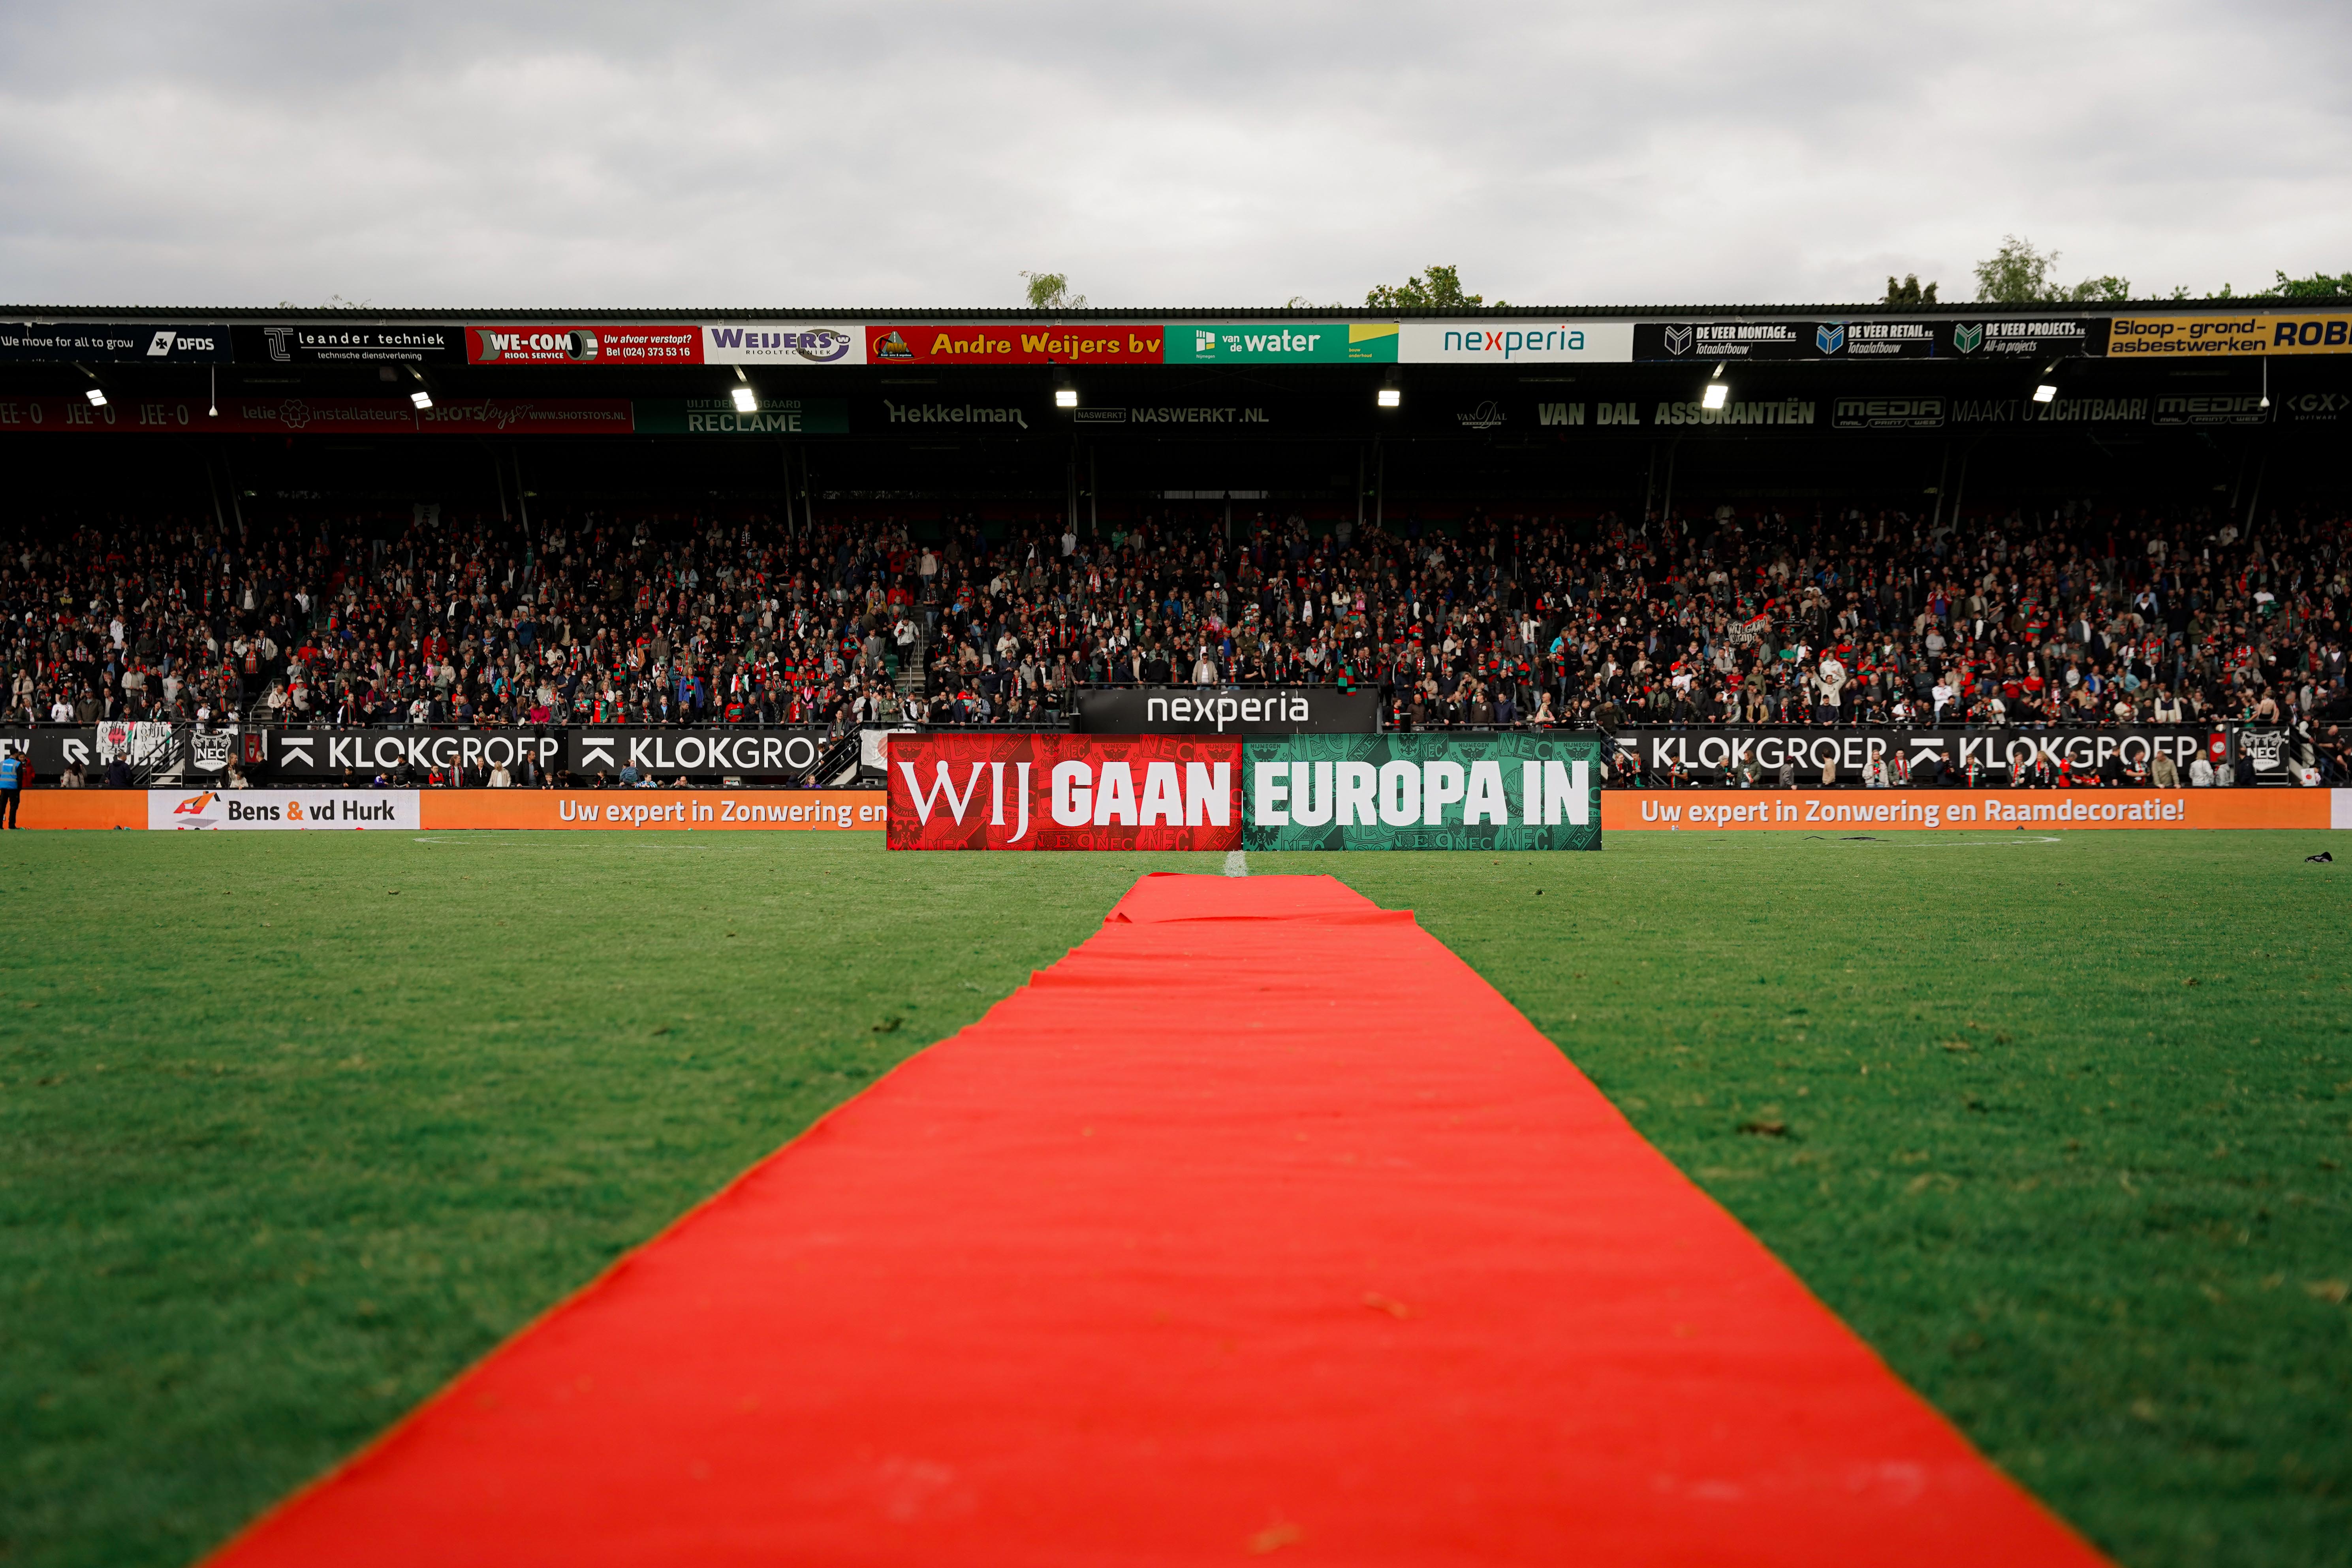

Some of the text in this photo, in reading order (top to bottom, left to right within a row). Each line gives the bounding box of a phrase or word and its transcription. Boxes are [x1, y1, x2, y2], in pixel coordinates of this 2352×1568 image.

[1696, 326, 1710, 339] DE
[1712, 326, 1736, 339] VEER
[1738, 326, 1787, 339] MONTAGE
[1848, 325, 1863, 338] DE
[1863, 325, 1888, 338] VEER
[1889, 324, 1923, 337] RETAIL
[1985, 323, 2000, 335] DE
[2000, 322, 2026, 335] VEER
[2028, 322, 2076, 335] PROJECTS
[2274, 321, 2352, 346] ROB
[1, 336, 134, 350] We move for all to grow
[177, 337, 214, 351] DFDS
[299, 332, 445, 345] leander techniek
[490, 334, 573, 351] WE-COM
[604, 334, 692, 345] Uw afvoer verstopt?
[1245, 329, 1321, 352] water
[1445, 326, 1584, 359] nexperia
[2112, 337, 2266, 352] asbestwerken
[606, 347, 690, 358] Bel (024) 373 53 16
[886, 342, 907, 353] AW
[931, 332, 1161, 360] Andre Weijers bv
[1230, 344, 1242, 352] de
[1696, 342, 1749, 355] Totaalafbouw
[1848, 342, 1902, 354] Totaalafbouw
[1983, 340, 2037, 354] All-in projects
[318, 352, 422, 361] technische dienstverlening
[687, 400, 711, 408] UIJT
[1538, 397, 1816, 425] VAN DAL ASSURANTIËN
[1837, 400, 1941, 416] MEDIA
[1952, 399, 2148, 422] MAAKT U ZICHTBAAR!
[2158, 397, 2265, 413] MEDIA
[242, 406, 276, 420] lelie
[883, 399, 1028, 430] Hekkelman
[689, 414, 802, 432] RECLAME
[1148, 691, 1309, 732] nexperia
[197, 748, 226, 759] NEC
[330, 737, 558, 768] KLOKGROEP
[630, 737, 826, 768] KLOKGRO
[1063, 744, 1085, 758] NEC
[1420, 743, 1442, 758] NEC
[1653, 737, 1886, 769] KLOKGROEP
[2247, 747, 2276, 758] NEC
[897, 760, 1032, 843] WIJ
[1051, 760, 1230, 826] GAAN
[1254, 760, 1508, 826] EUROPA
[1524, 761, 1589, 825] IN
[229, 800, 395, 820] Bens & vd Hurk
[560, 800, 887, 828] Uw expert in Zonwering en
[1642, 798, 2185, 827] Uw expert in Zonwering en Raamdecoratie!
[1096, 837, 1133, 850] NEC
[1455, 837, 1491, 850] NEC
